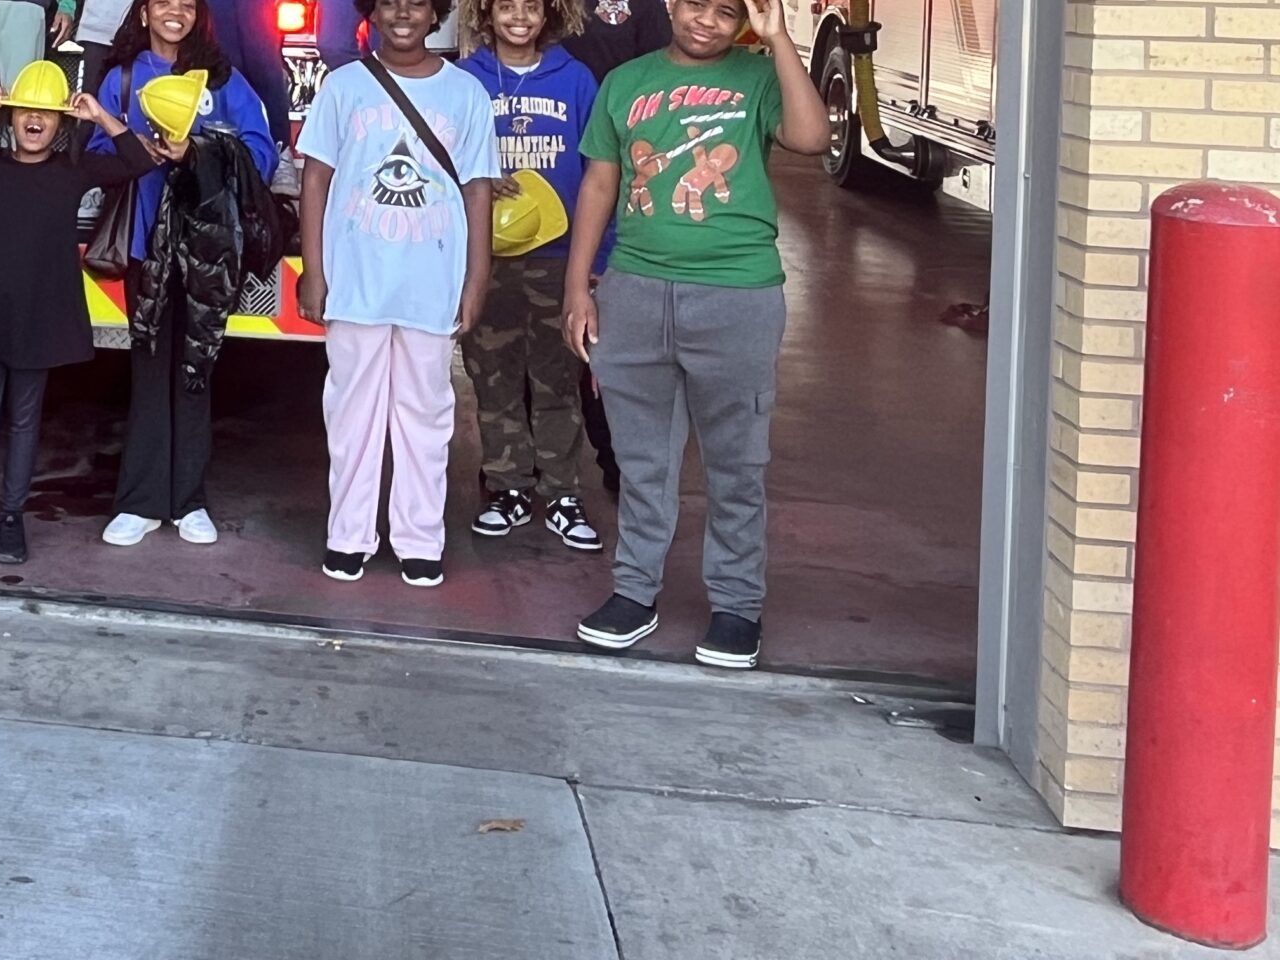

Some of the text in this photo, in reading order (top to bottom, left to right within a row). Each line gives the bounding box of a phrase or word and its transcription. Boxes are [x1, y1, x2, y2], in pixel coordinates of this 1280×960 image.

[352, 104, 457, 151] PIK
[626, 90, 665, 128] OH
[496, 135, 566, 152] ONAUTICAL
[498, 151, 557, 169] IVERSITY
[344, 188, 451, 242] FLOYD
